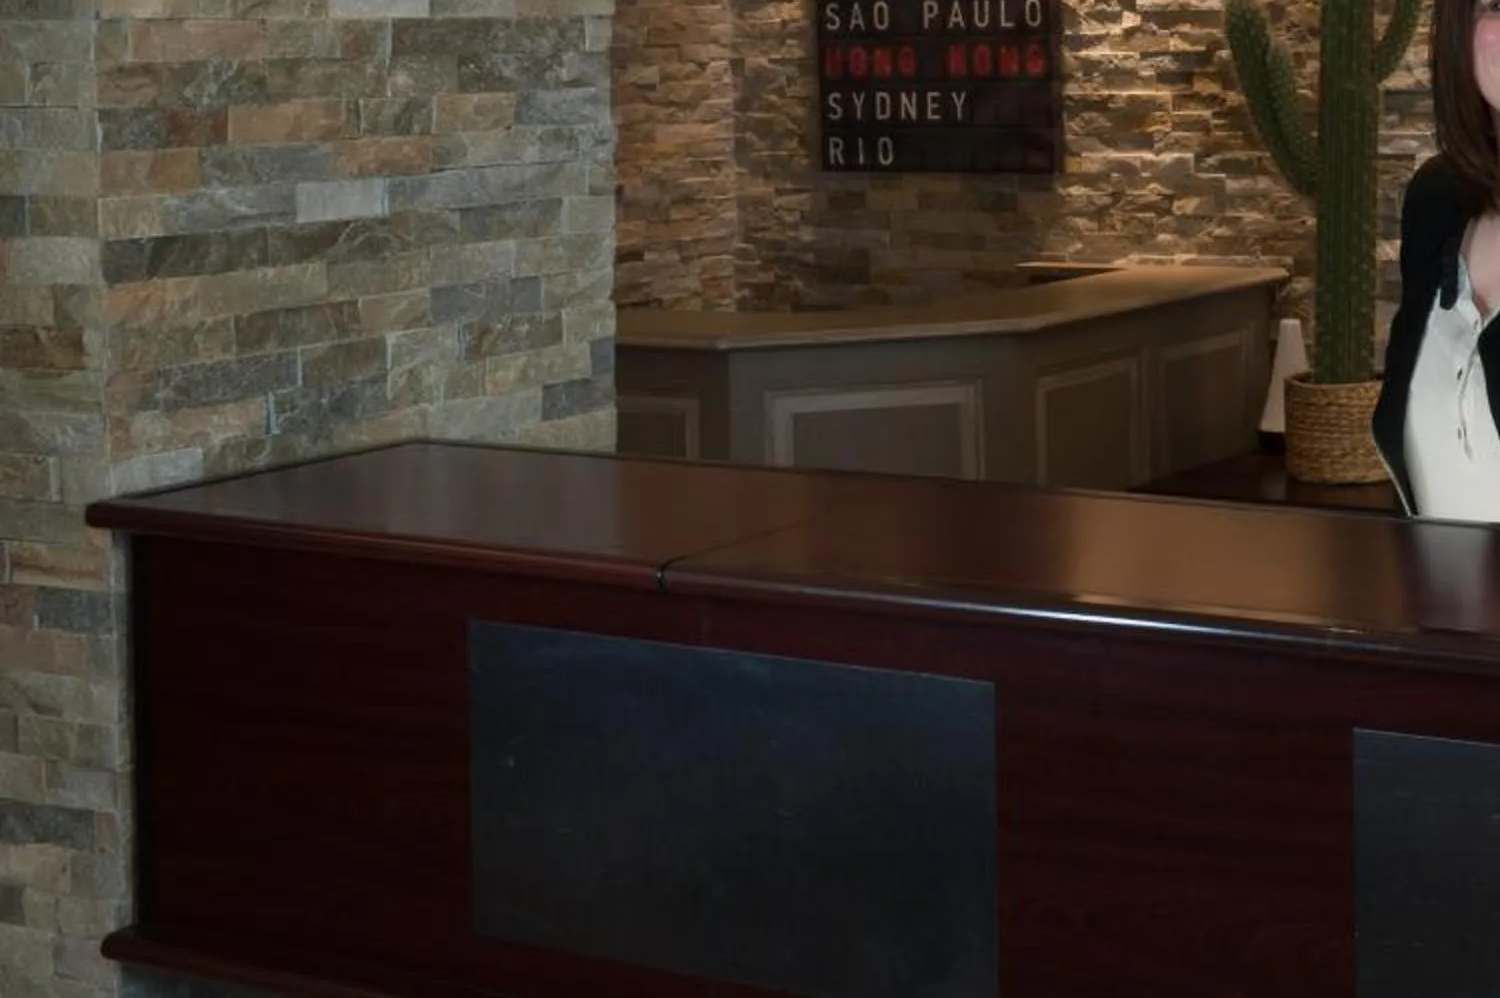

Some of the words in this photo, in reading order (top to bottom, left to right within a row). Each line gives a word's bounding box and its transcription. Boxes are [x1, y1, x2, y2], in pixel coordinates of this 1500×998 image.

[826, 1, 890, 31] SAO
[826, 44, 917, 79] HONG
[946, 41, 1046, 78] KONG
[828, 89, 967, 121] SYDNEY
[829, 136, 894, 166] RIO
